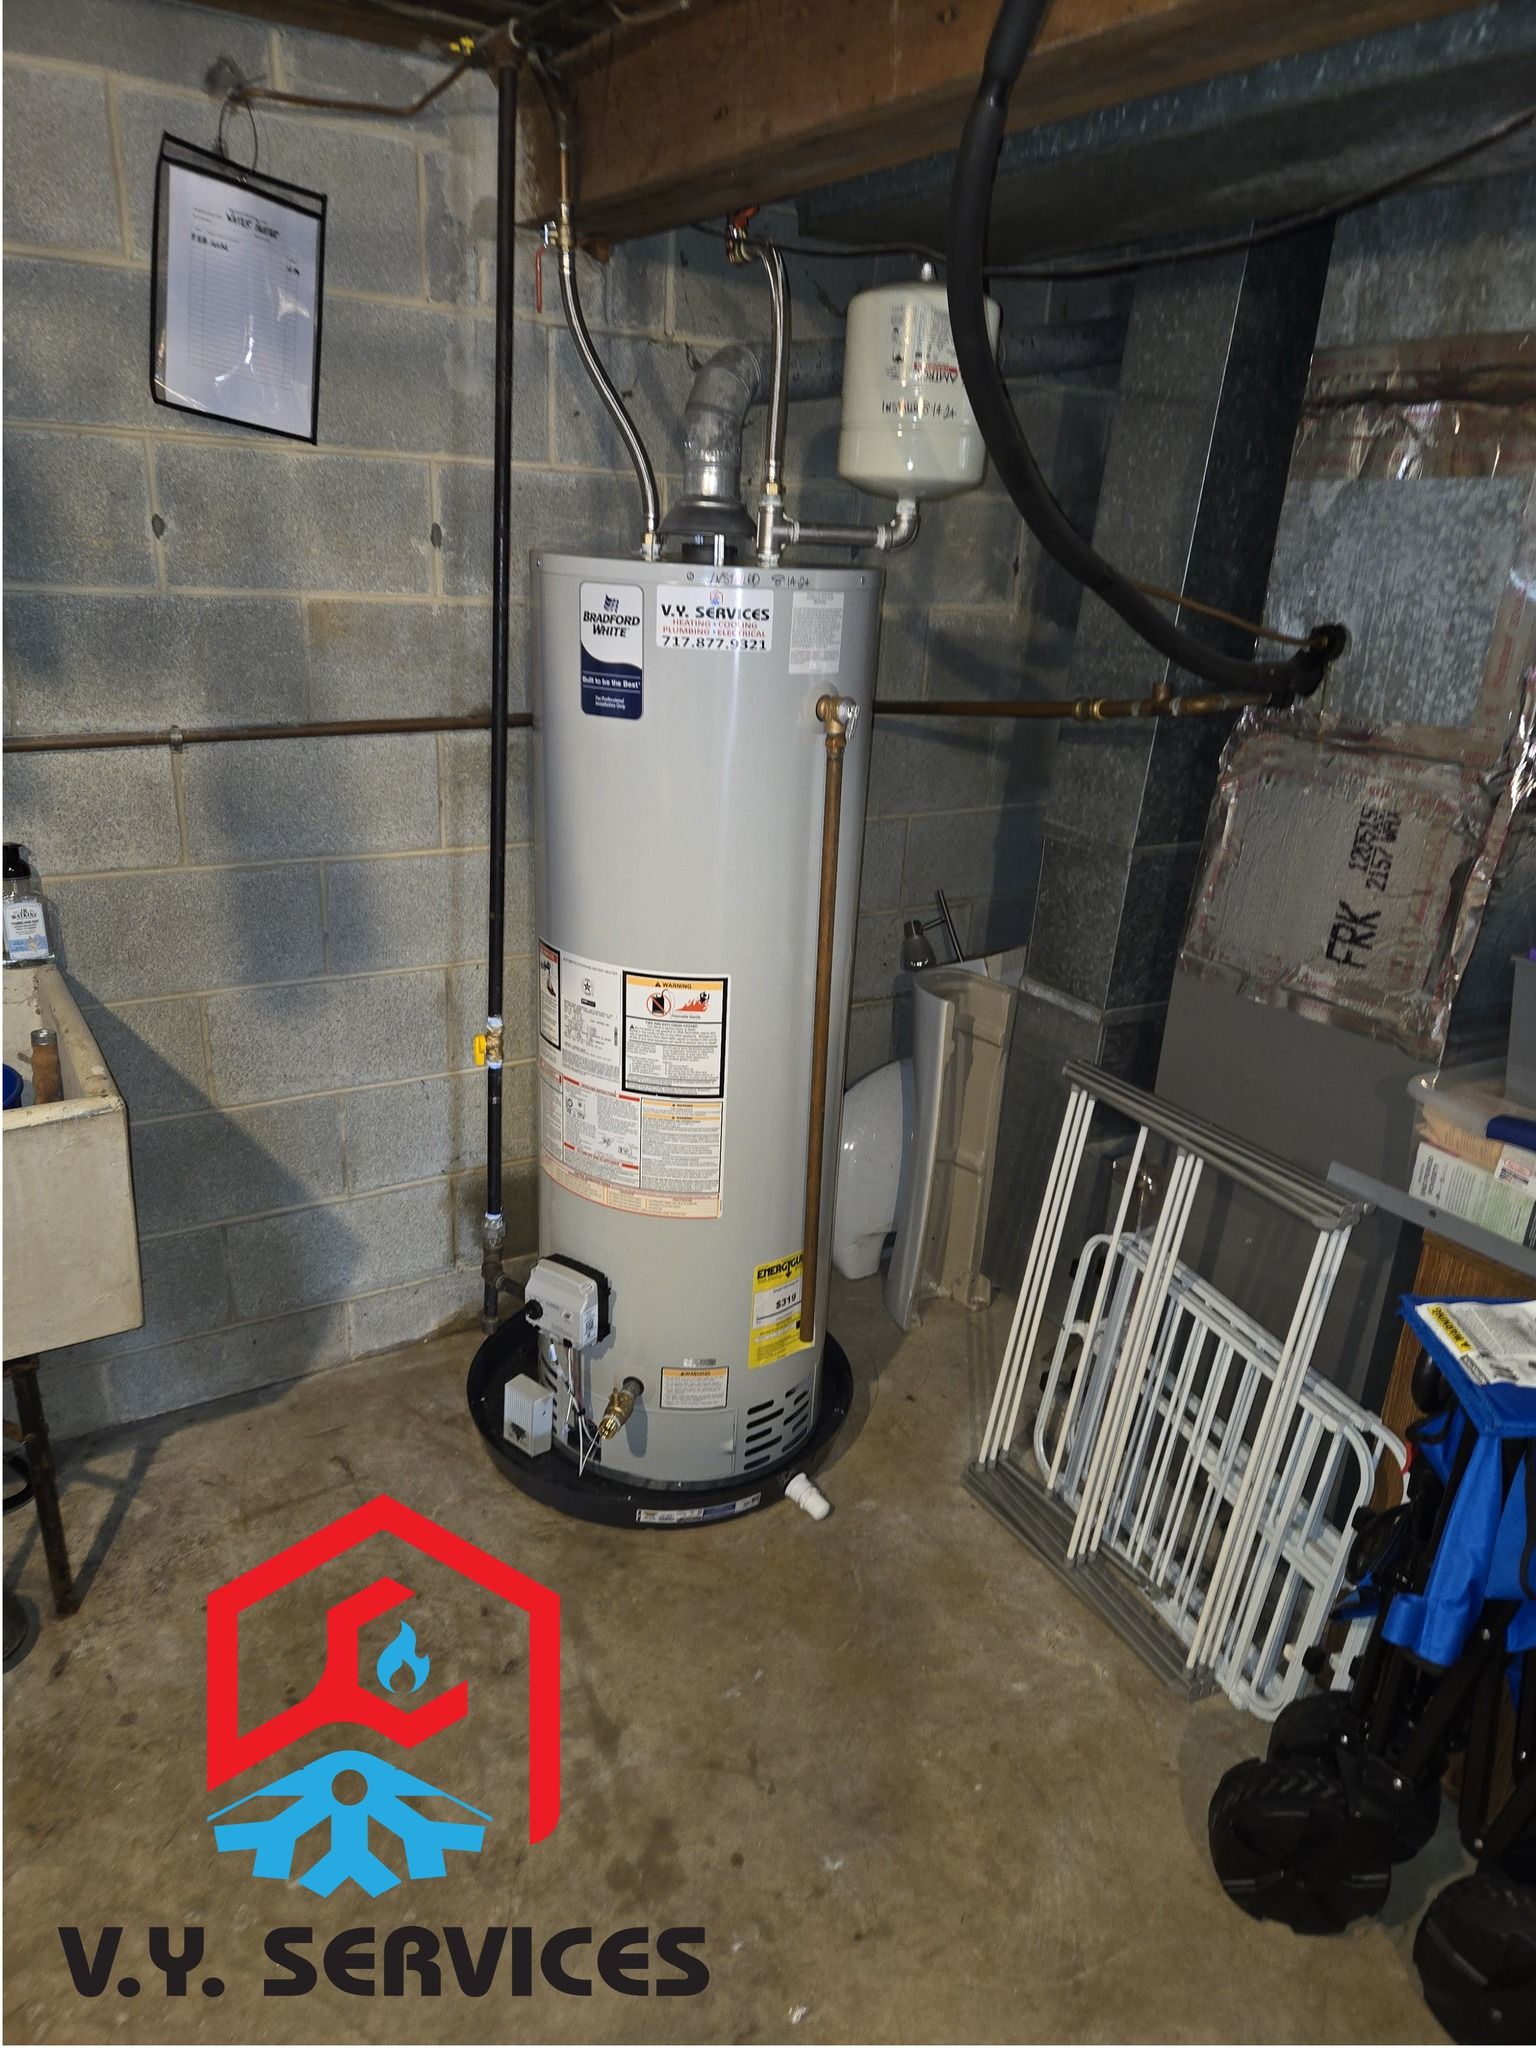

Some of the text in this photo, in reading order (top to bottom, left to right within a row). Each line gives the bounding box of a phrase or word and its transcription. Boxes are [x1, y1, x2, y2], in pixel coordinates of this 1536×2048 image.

[583, 611, 640, 626] BRADFORD
[661, 604, 770, 621] V.Y. SERVICES
[672, 618, 711, 627] HEATING
[593, 624, 627, 637] WHITE
[663, 626, 710, 636] PLUMBING
[662, 635, 767, 651] 717.877.9321
[582, 675, 594, 684] Built
[595, 677, 601, 685] to
[602, 678, 610, 686] be
[611, 679, 622, 687] the
[1326, 899, 1382, 969] FRK
[662, 982, 692, 990] WARNING
